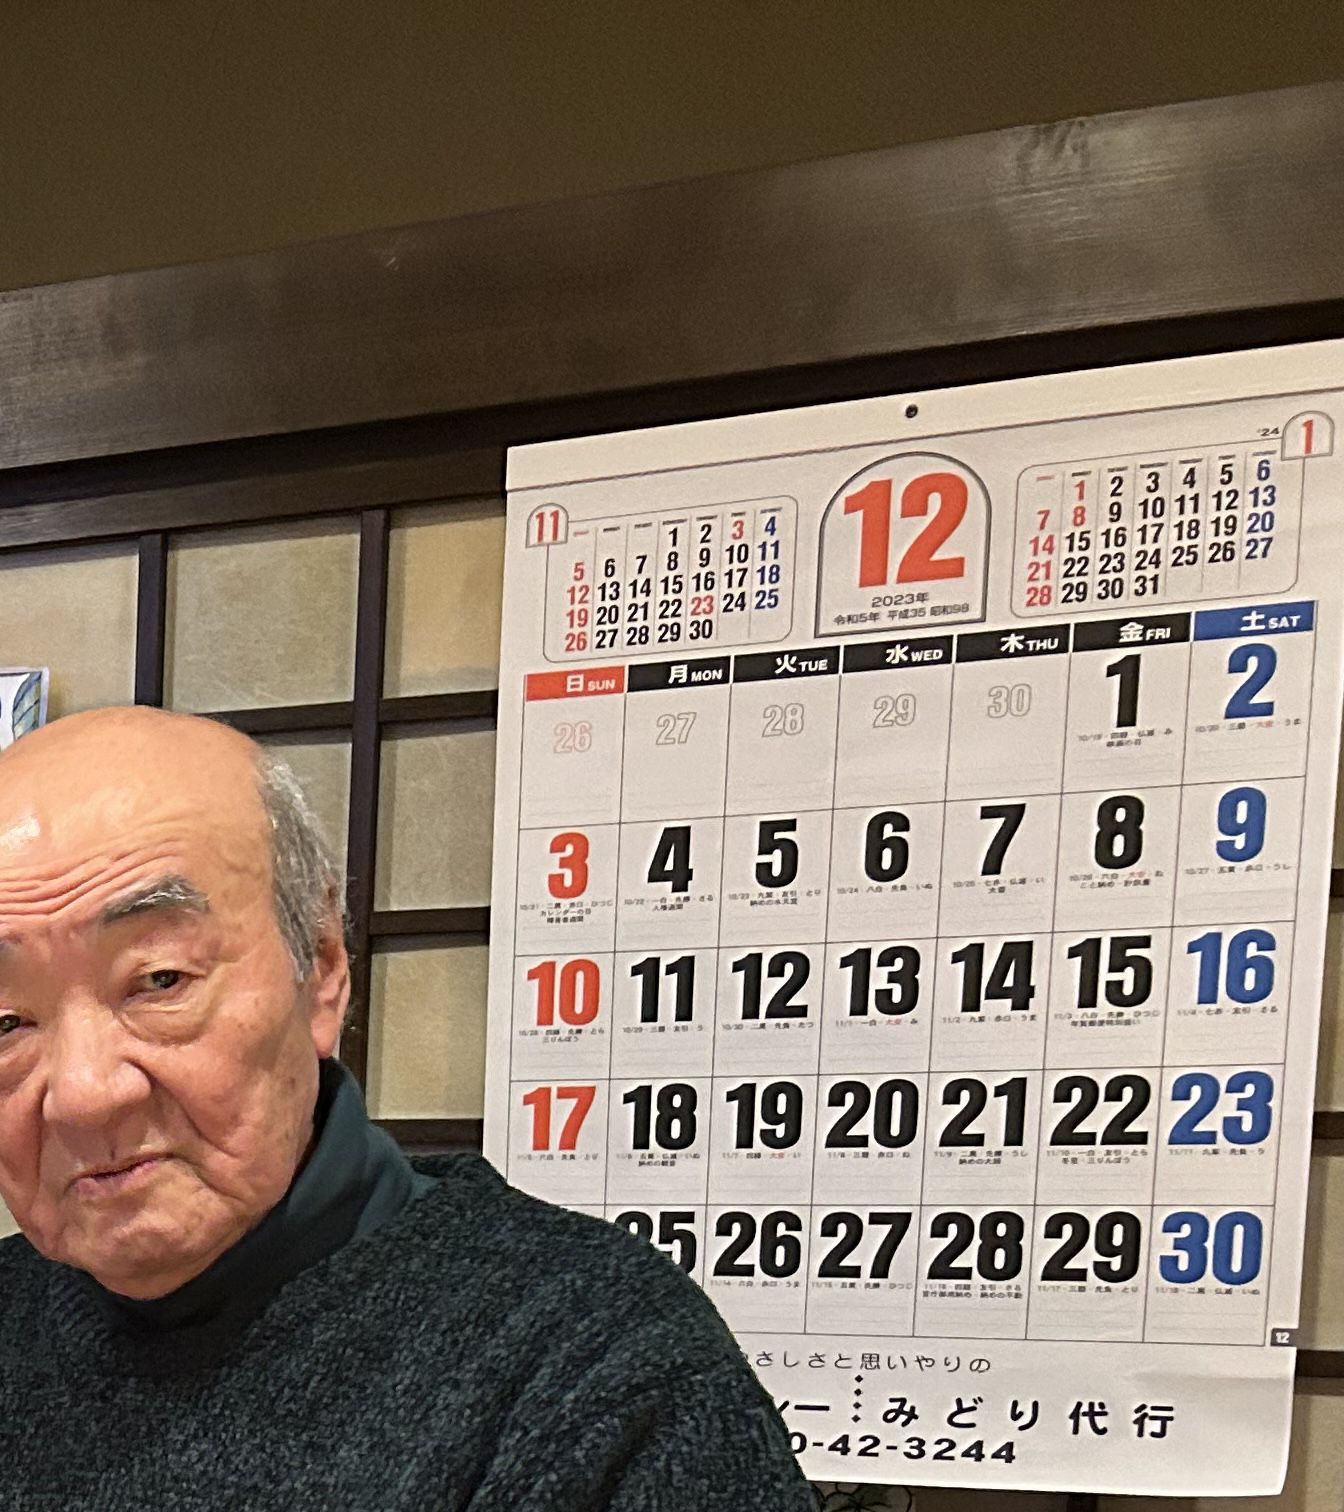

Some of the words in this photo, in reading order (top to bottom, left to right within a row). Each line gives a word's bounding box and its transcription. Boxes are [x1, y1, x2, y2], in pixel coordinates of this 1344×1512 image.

[1302, 420, 1313, 454] 1
[1075, 480, 1085, 501] 1
[1110, 476, 1123, 497] 2
[1146, 472, 1160, 493] 3
[1183, 467, 1196, 488] 4
[1220, 463, 1233, 485] 5
[1257, 460, 1270, 481] 6
[536, 510, 560, 543] 11
[1037, 510, 1050, 531] 7
[1072, 506, 1086, 527] 8
[1109, 502, 1121, 523] 9
[1139, 497, 1165, 519] 10
[1175, 493, 1199, 515] 11
[1212, 489, 1239, 511] 12
[1249, 485, 1276, 508] 13
[669, 528, 677, 547] 1
[700, 524, 711, 544] 2
[732, 520, 744, 540] 3
[765, 516, 776, 536] 4
[843, 473, 969, 588] 12
[1029, 534, 1054, 556] 14
[1066, 530, 1091, 552] 15
[1101, 527, 1127, 548] 16
[1137, 523, 1164, 545] 17
[1174, 519, 1200, 541] 18
[1211, 515, 1237, 537] 19
[1247, 511, 1274, 534] 20
[574, 562, 584, 581] 5
[605, 558, 615, 578] 6
[636, 555, 647, 574] 7
[667, 551, 678, 571] 8
[699, 548, 710, 568] 9
[726, 544, 748, 564] 10
[758, 540, 779, 561] 11
[1027, 560, 1051, 582] 21
[1063, 556, 1089, 578] 22
[1099, 552, 1125, 574] 23
[1135, 548, 1161, 571] 24
[1171, 544, 1198, 567] 25
[1208, 541, 1235, 563] 26
[1245, 537, 1273, 560] 27
[567, 585, 589, 605] 12
[598, 581, 620, 601] 13
[629, 578, 651, 598] 14
[660, 575, 683, 594] 15
[692, 571, 715, 592] 16
[725, 568, 748, 588] 17
[757, 564, 780, 585] 18
[871, 592, 929, 608] 2023年
[1026, 585, 1052, 607] 28
[1061, 581, 1088, 603] 29
[1097, 578, 1124, 600] 30
[1134, 574, 1159, 596] 31
[566, 608, 588, 628] 19
[596, 605, 619, 625] 20
[627, 602, 648, 622] 21
[659, 599, 682, 619] 22
[691, 595, 714, 616] 23
[722, 591, 746, 613] 24
[755, 588, 779, 609] 25
[834, 611, 880, 624] 令和5年
[565, 631, 587, 652] 26
[595, 629, 618, 649] 27
[627, 625, 649, 646] 28
[658, 622, 681, 643] 29
[689, 619, 713, 640] 30
[566, 674, 583, 692] 日
[668, 664, 687, 684] 月
[691, 668, 723, 682] MON
[775, 655, 796, 673] 火
[799, 659, 828, 672] TUE
[885, 646, 909, 665] 水
[910, 648, 943, 662] WED
[1000, 635, 1024, 653] 木
[1027, 637, 1059, 652] THU
[1118, 622, 1145, 642] 金
[1146, 627, 1171, 640] FRI
[1241, 612, 1265, 630] 土
[1268, 615, 1301, 629] SAT
[553, 723, 592, 754] 26
[655, 712, 697, 746] 27
[762, 704, 805, 738] 28
[872, 694, 916, 728] 29
[986, 684, 1032, 719] 30
[1106, 654, 1141, 728] 1
[1224, 643, 1277, 719] 2
[548, 832, 589, 899] 3
[648, 826, 693, 893] 4
[756, 818, 798, 888] 5
[865, 811, 910, 882] 6
[980, 803, 1026, 876] 7
[1095, 795, 1144, 869] 8
[1216, 787, 1266, 862] 9
[528, 959, 600, 1026] 10
[631, 955, 695, 1023] 11
[732, 951, 810, 1020] 12
[840, 946, 920, 1016] 13
[951, 940, 1035, 1012] 14
[1067, 935, 1153, 1008] 15
[1187, 929, 1276, 1005] 16
[523, 1086, 596, 1151] 17
[623, 1083, 697, 1150] 18
[726, 1081, 803, 1149] 19
[825, 1079, 919, 1148] 20
[939, 1077, 1027, 1147] 21
[1050, 1075, 1151, 1146] 22
[1168, 1071, 1274, 1145] 23
[713, 1211, 802, 1278] 26
[818, 1212, 912, 1279] 27
[927, 1211, 1024, 1281] 28
[1041, 1211, 1141, 1283] 29
[1160, 1211, 1263, 1285] 30
[743, 1351, 991, 1373] さしさと思いやりの
[882, 1397, 1175, 1439] みどり代行
